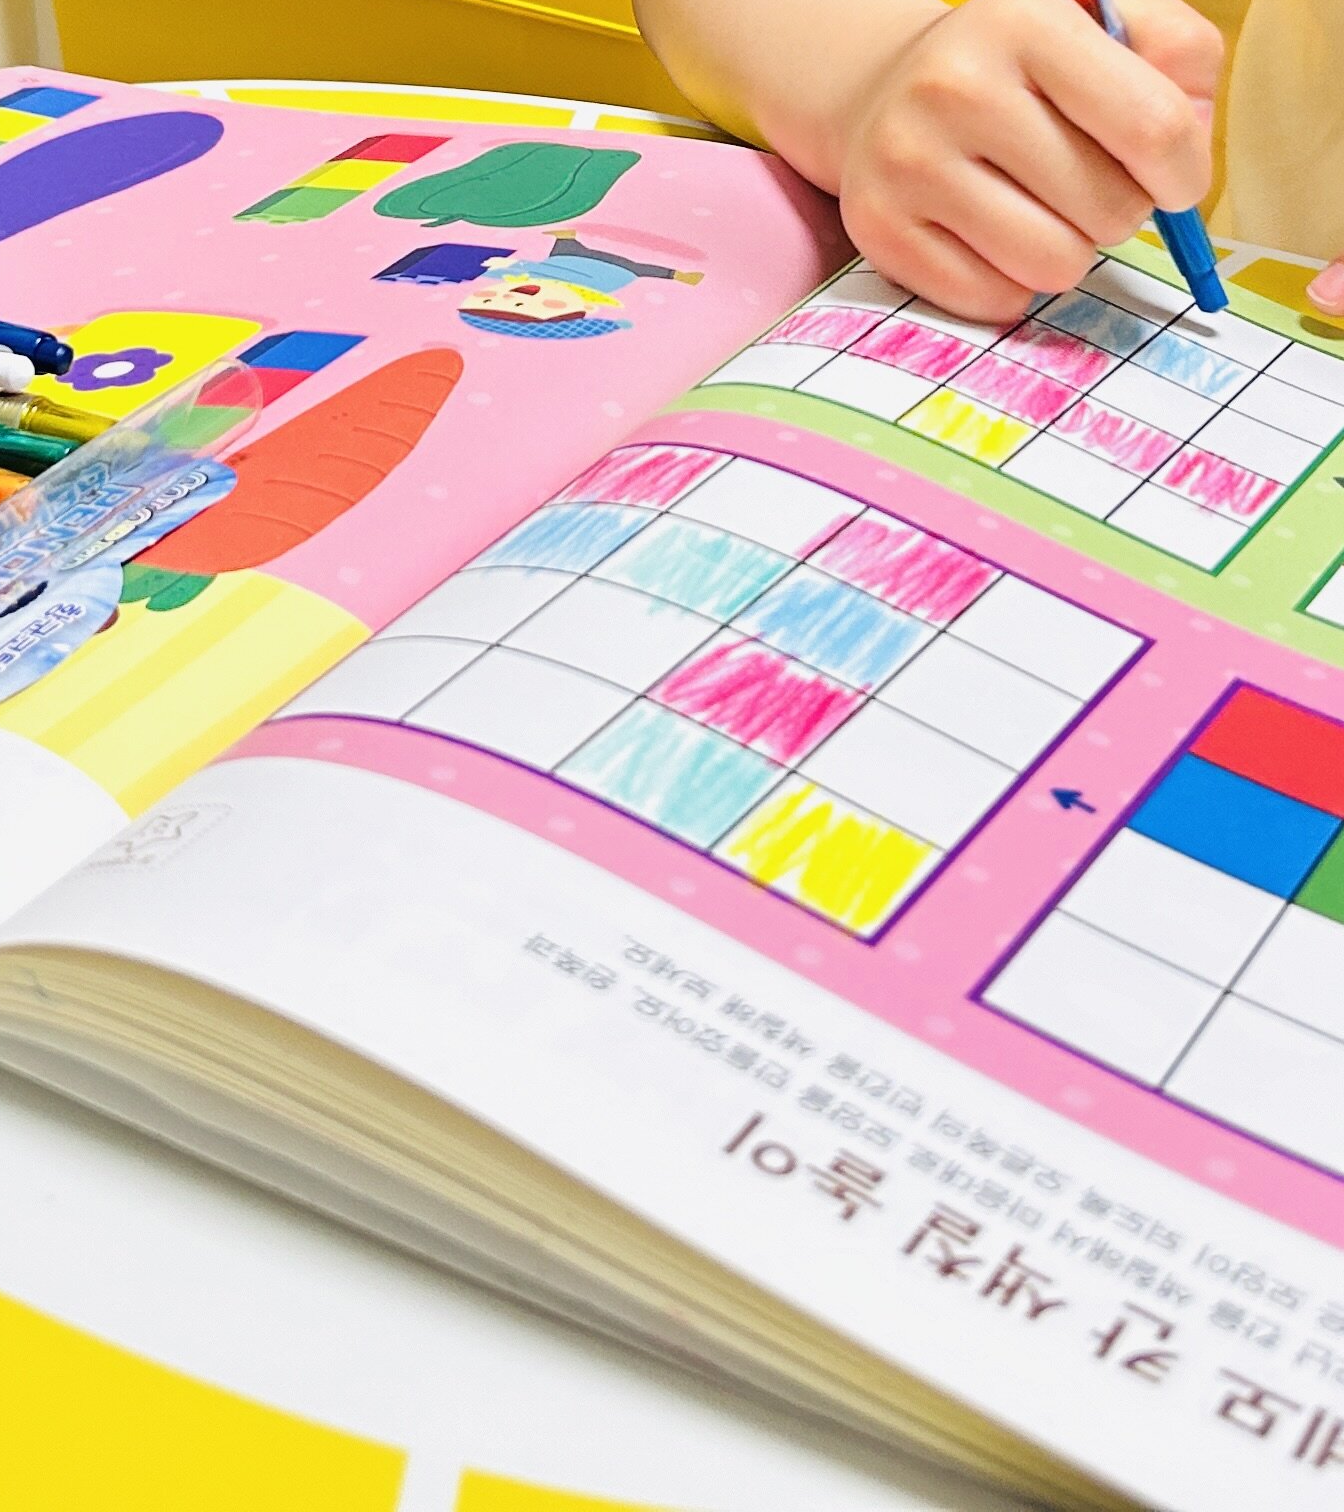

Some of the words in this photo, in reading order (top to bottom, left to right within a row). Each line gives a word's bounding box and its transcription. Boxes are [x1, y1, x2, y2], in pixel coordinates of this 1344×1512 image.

[714, 1111, 893, 1229] 놀이
[902, 1202, 1068, 1320] 색칠
[1192, 1243, 1308, 1313] 모양이
[1083, 1294, 1189, 1385] 칸
